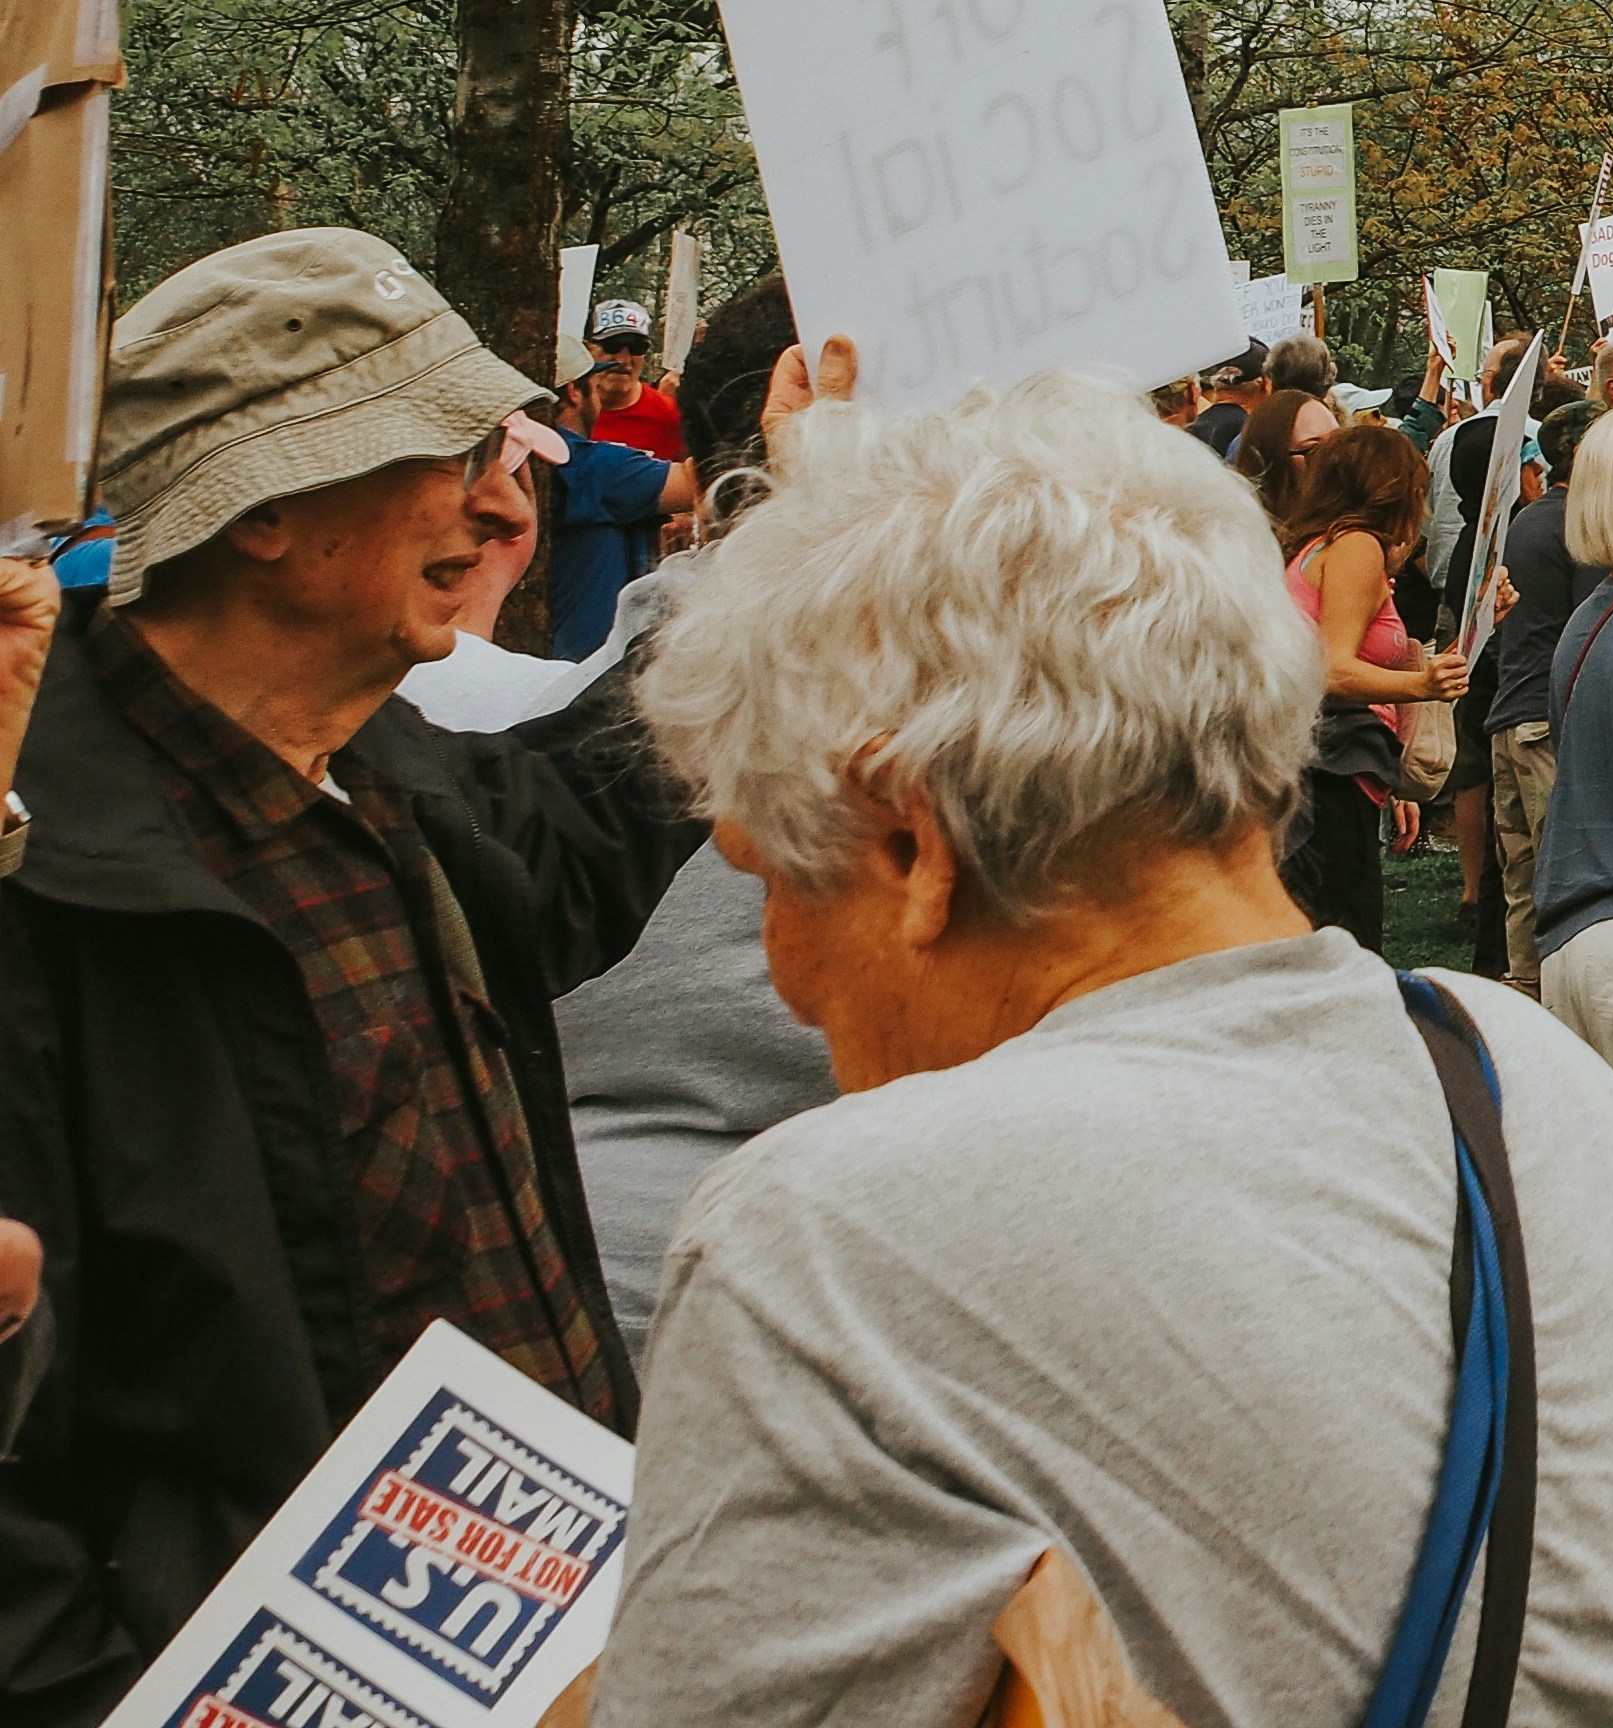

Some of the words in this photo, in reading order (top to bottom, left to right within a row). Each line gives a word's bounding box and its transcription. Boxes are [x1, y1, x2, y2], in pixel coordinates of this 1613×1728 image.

[1299, 200, 1338, 214] TYRANNY
[1304, 216, 1323, 227] DIES
[1308, 242, 1332, 254] LIGHT
[1311, 229, 1328, 239] THE
[449, 1437, 594, 1553] MAIL
[372, 1479, 459, 1544] SALE
[457, 1520, 523, 1571] FOR
[514, 1550, 582, 1598] NOT
